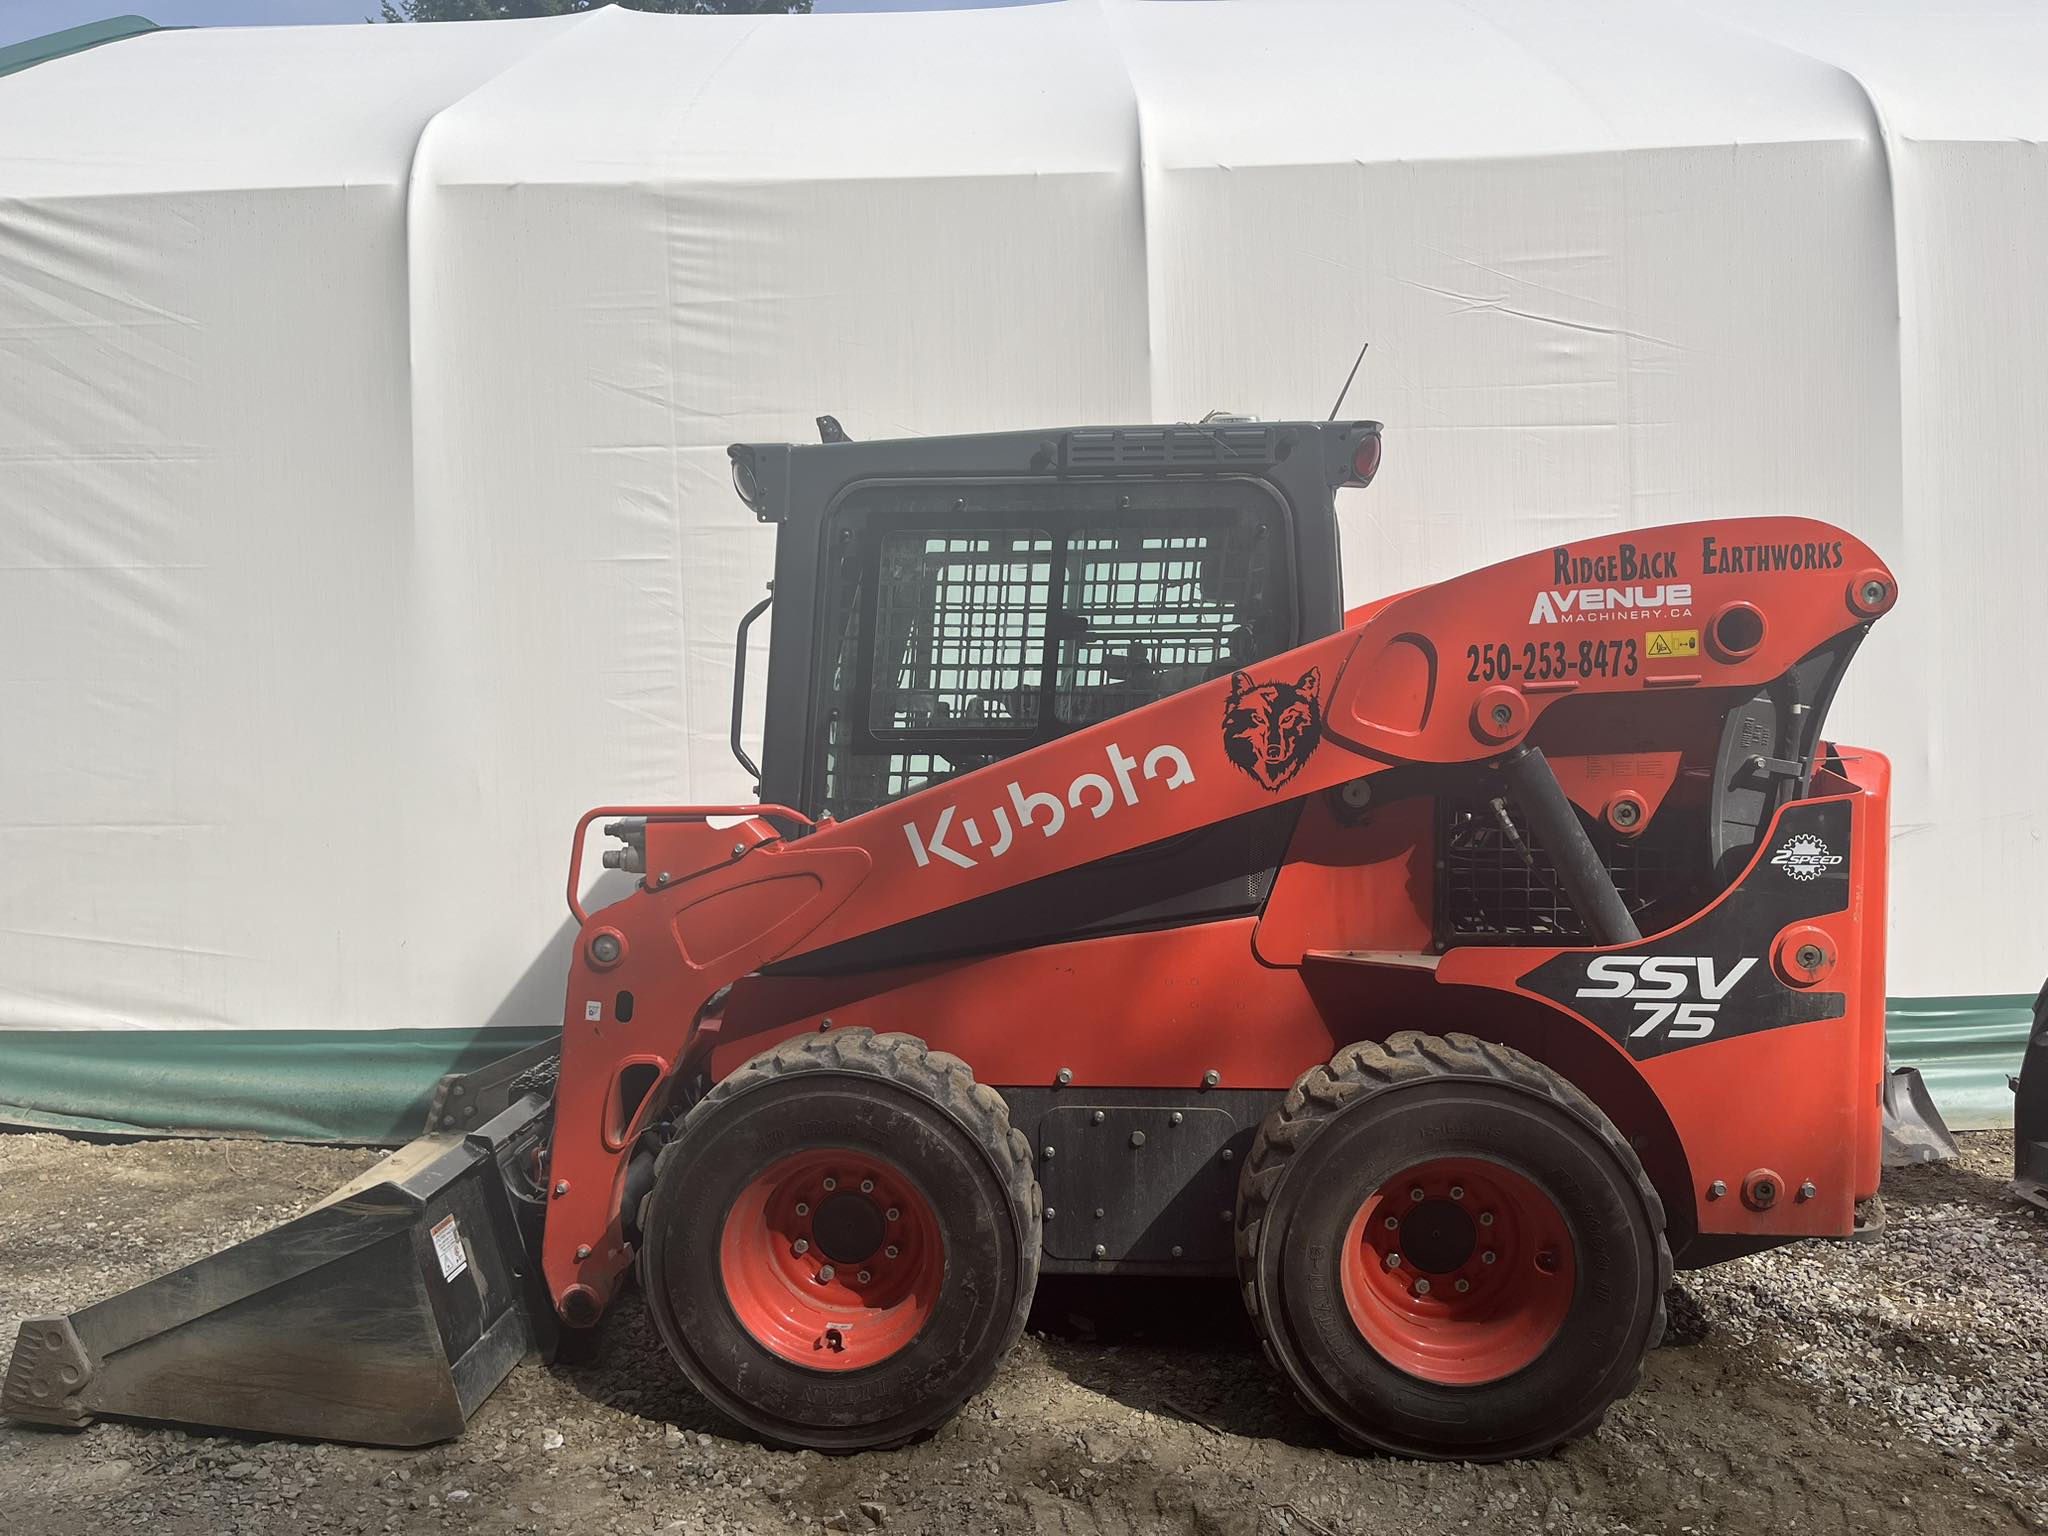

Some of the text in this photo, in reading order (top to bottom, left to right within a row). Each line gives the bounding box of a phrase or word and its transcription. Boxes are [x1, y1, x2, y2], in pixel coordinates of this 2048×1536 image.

[1528, 583, 1693, 625] AVENUE
[1560, 608, 1693, 624] MACHINERY.CA
[1466, 638, 1639, 682] 250-253-8473
[902, 741, 1196, 870] Kubota
[1575, 955, 1760, 1000] SSV
[1629, 1002, 1720, 1039] 75
